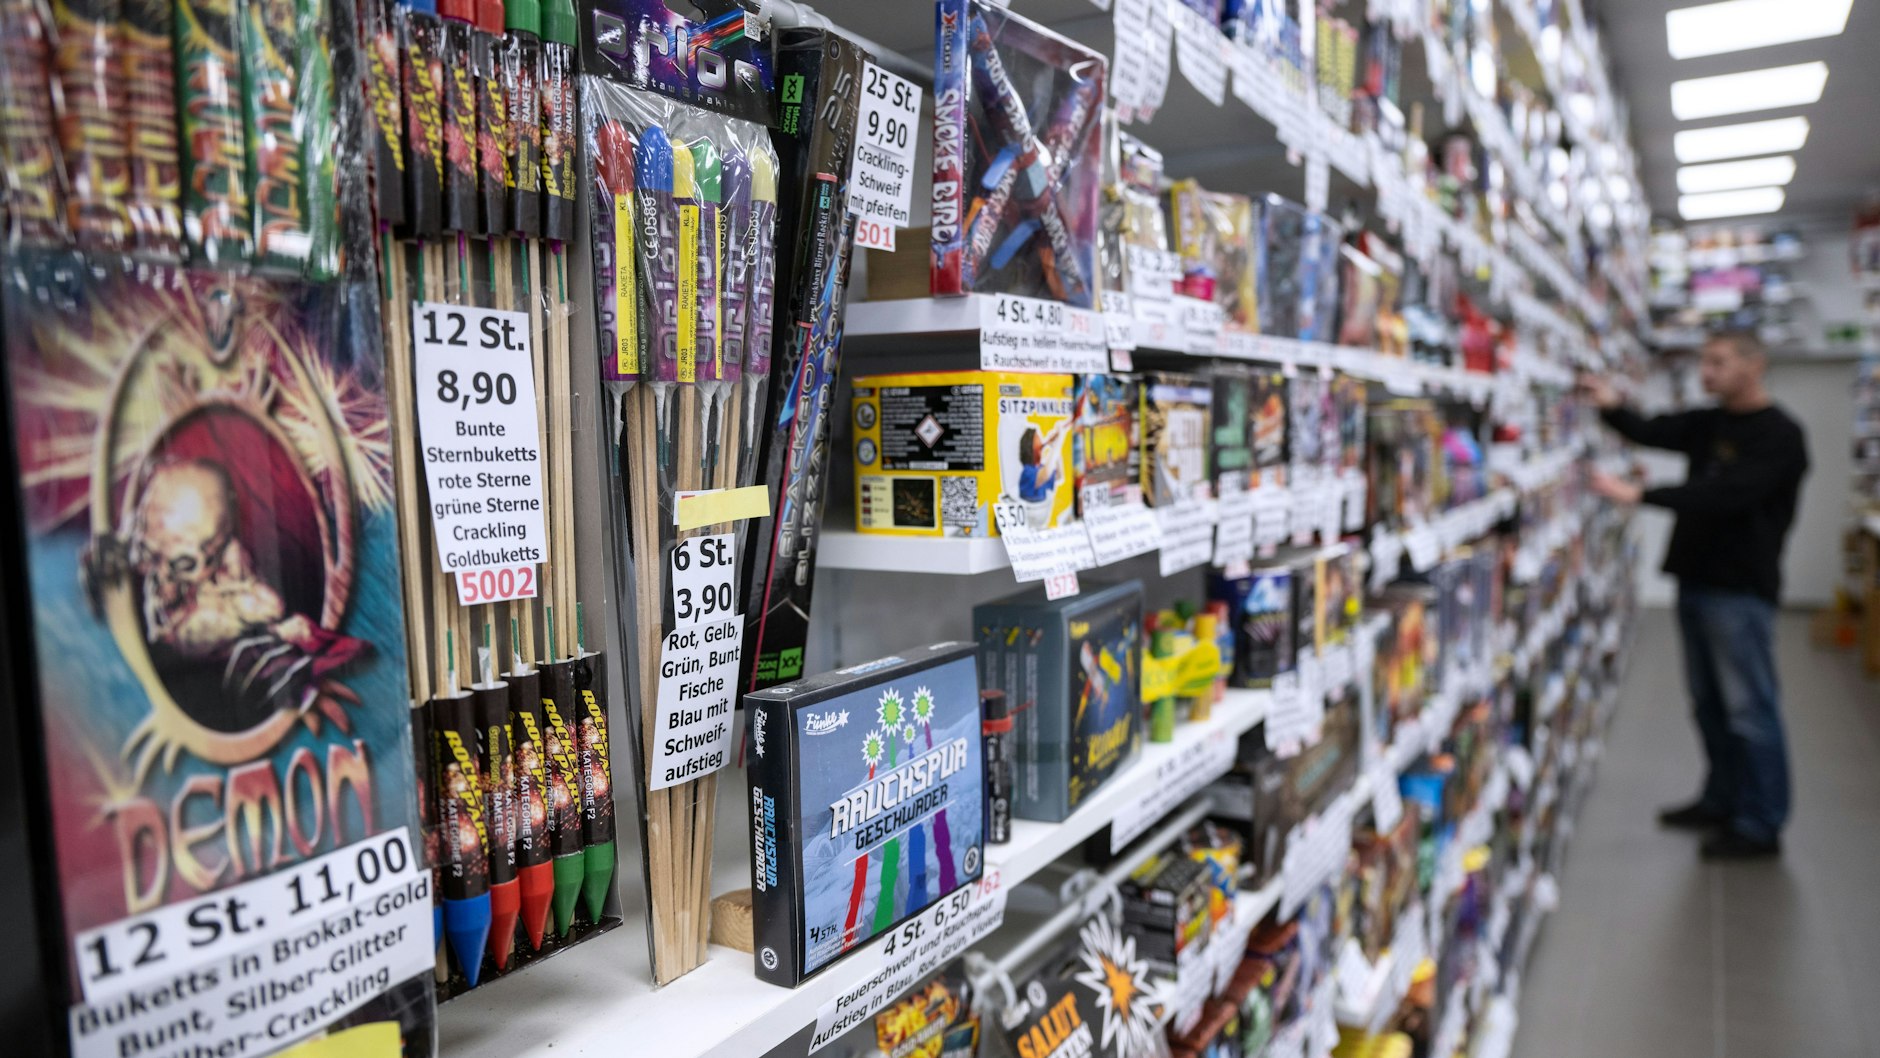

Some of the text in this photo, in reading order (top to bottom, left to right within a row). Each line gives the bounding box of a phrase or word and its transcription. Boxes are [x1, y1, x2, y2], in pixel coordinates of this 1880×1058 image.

[521, 78, 531, 123] RAKETE
[552, 70, 563, 132] KATEGORIE
[866, 68, 915, 114] 25 St.
[564, 90, 573, 133] RAKETE
[868, 110, 908, 150] 9,90
[857, 145, 910, 179] Crackling-
[932, 89, 959, 243] SMOKE BIRD
[859, 171, 902, 197] Schweif
[816, 212, 829, 238] Rocket
[850, 194, 908, 223] mit pfeifen
[857, 220, 893, 249] 501
[813, 238, 825, 268] Blizzard
[620, 265, 628, 298] RAKIETA
[681, 279, 689, 310] RAKIETA
[997, 299, 1007, 323] 4
[1011, 301, 1030, 324] St.
[423, 311, 525, 351] 12 St.
[620, 338, 629, 356] JR03
[982, 331, 1018, 350] Aufstieg
[680, 348, 688, 366] JR03
[437, 370, 517, 411] 8,90
[456, 421, 506, 437] Bunte
[427, 446, 537, 463] Sternbuketts
[438, 472, 532, 489] rote Sterne
[435, 497, 540, 519] grüne Sterne
[453, 521, 527, 541] Crackling
[446, 546, 540, 568] Goldbuketts
[674, 538, 733, 572] 6 St.
[461, 567, 534, 603] 5002
[677, 582, 732, 623] 3,90
[668, 622, 739, 651] Rot, Gelb,
[662, 646, 740, 679] Grün, Bunt
[679, 676, 724, 701] Fische
[668, 698, 729, 730] Blau mit
[664, 722, 727, 757] Schweif-
[665, 750, 723, 782] aufstieg
[582, 750, 596, 820] KATEGORIE F2
[830, 737, 968, 839] RAUCHSPUR
[101, 738, 377, 916] DEMON
[493, 792, 503, 836] RAKETE
[505, 790, 515, 850] KATEGORIE
[520, 775, 532, 850] KATEGORIE F2
[855, 784, 948, 850] GESCHWADER
[448, 799, 463, 878] KATEGORIE F2
[753, 786, 767, 892] GESCHWADER
[763, 795, 777, 888] RAUCHSPUR
[507, 851, 515, 866] F2
[975, 871, 1001, 900] 762
[87, 836, 408, 983] 12 St. 11,00
[884, 889, 970, 956] 4 St. 6,50
[810, 925, 820, 943] 4
[78, 877, 430, 1037] Buketts in Brokat-Gold
[835, 945, 918, 1014] Feuerschweif
[919, 935, 942, 957] und
[943, 898, 994, 941] Rauchspur
[118, 922, 408, 1058] Bunt, Silber-Glitter
[811, 1003, 869, 1051] Aufstieg
[871, 996, 883, 1009] in
